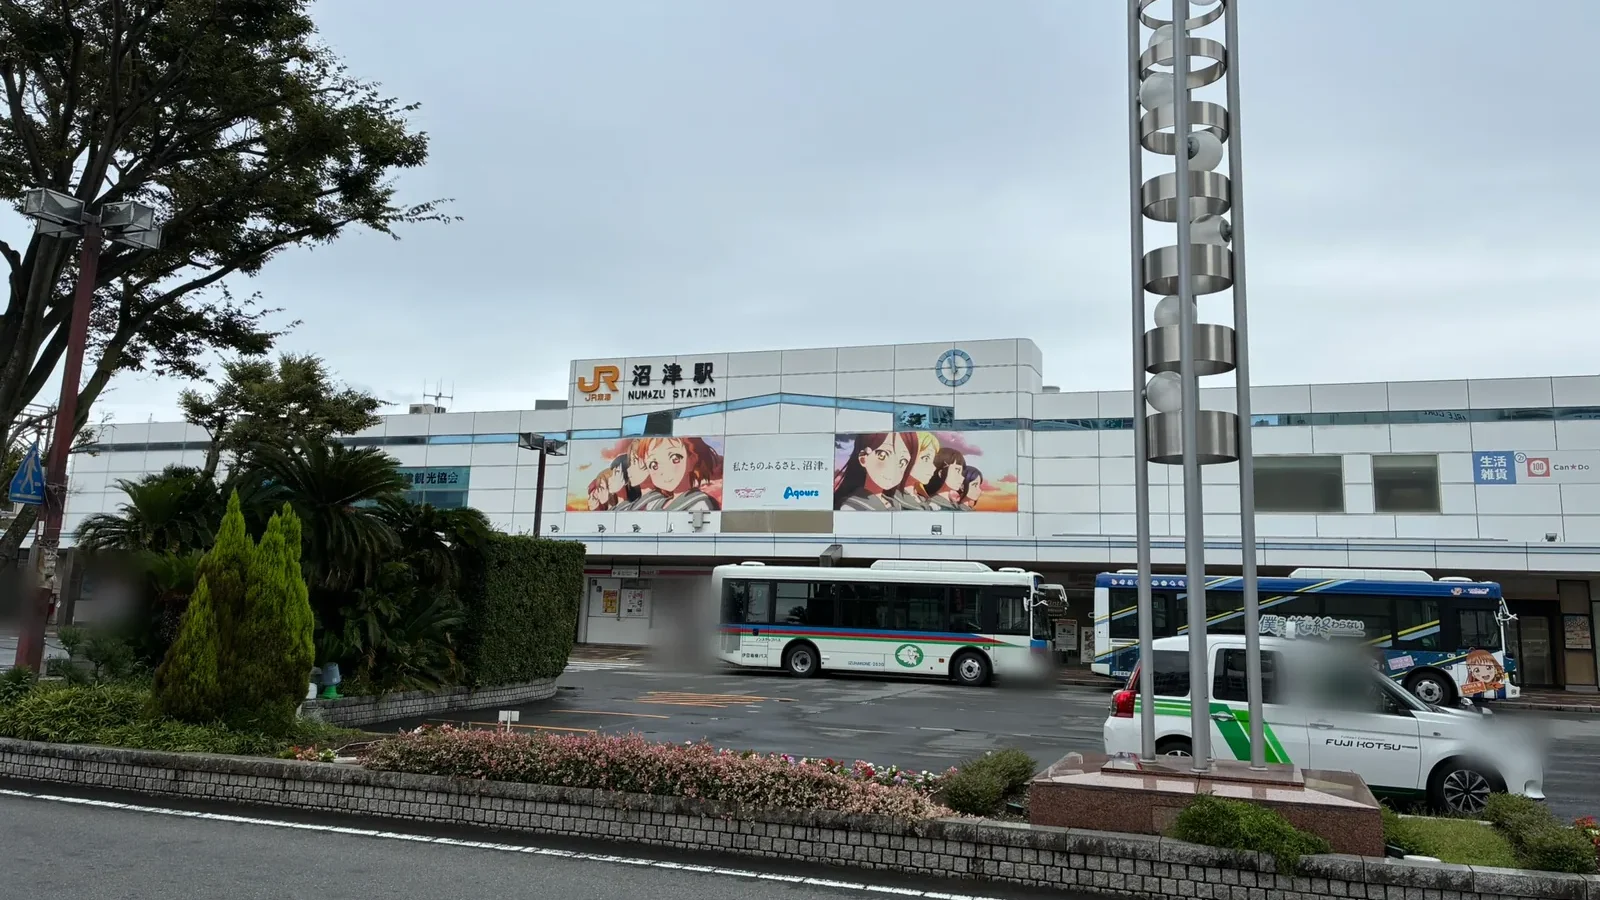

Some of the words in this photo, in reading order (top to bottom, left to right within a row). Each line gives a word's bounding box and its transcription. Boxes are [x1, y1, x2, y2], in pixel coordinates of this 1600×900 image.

[578, 366, 619, 392] JR
[632, 363, 714, 386] 沼津駅
[628, 390, 666, 400] NUMAZU
[673, 388, 716, 398] STATION
[733, 460, 828, 471] 私たちのふるさと、沼津。
[1480, 455, 1507, 468] 生活
[1533, 462, 1544, 471] 100
[1481, 468, 1508, 481] 雑貨
[784, 486, 819, 500] Aqours
[1326, 738, 1353, 747] FUJI
[1356, 741, 1401, 751] KOTSU
